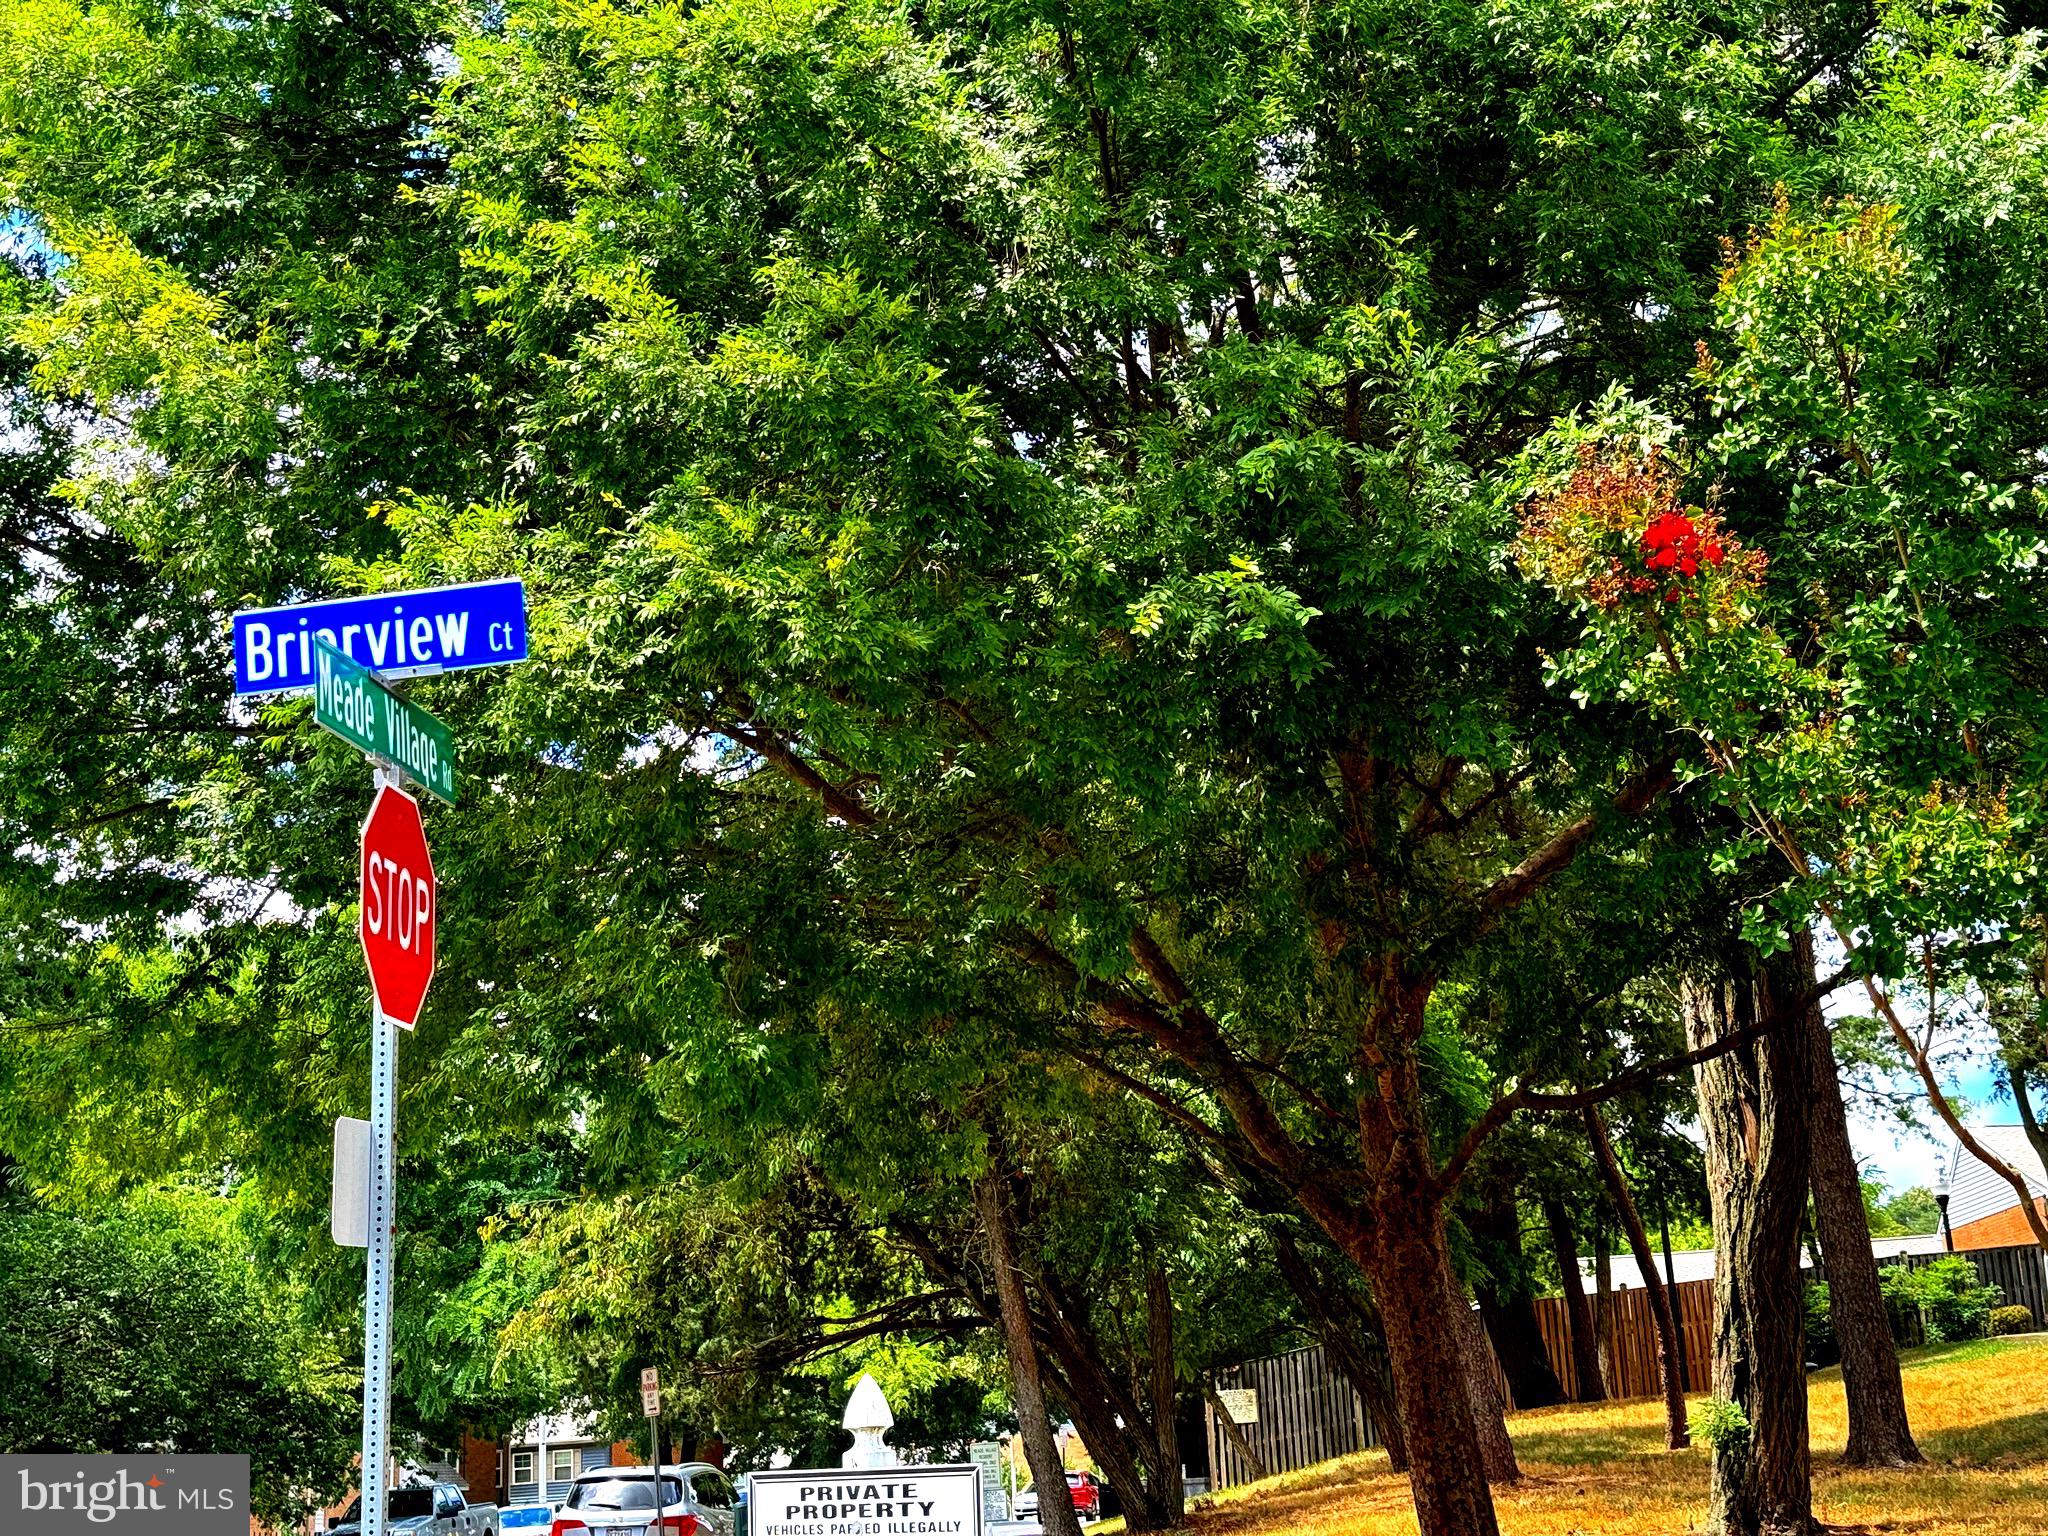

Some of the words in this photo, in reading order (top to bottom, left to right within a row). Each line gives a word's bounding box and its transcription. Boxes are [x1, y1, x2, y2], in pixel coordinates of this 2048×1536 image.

[488, 621, 514, 652] Ct
[318, 647, 376, 743] Meade
[383, 692, 439, 788] Village
[442, 759, 452, 793] Rd
[367, 850, 431, 955] STOP
[800, 1483, 918, 1502] PRIVATE
[786, 1501, 935, 1520] PROPERTY
[766, 1522, 824, 1536] VEHICLES
[831, 1521, 881, 1535] PARED
[888, 1520, 962, 1534] ILLEGALLY
